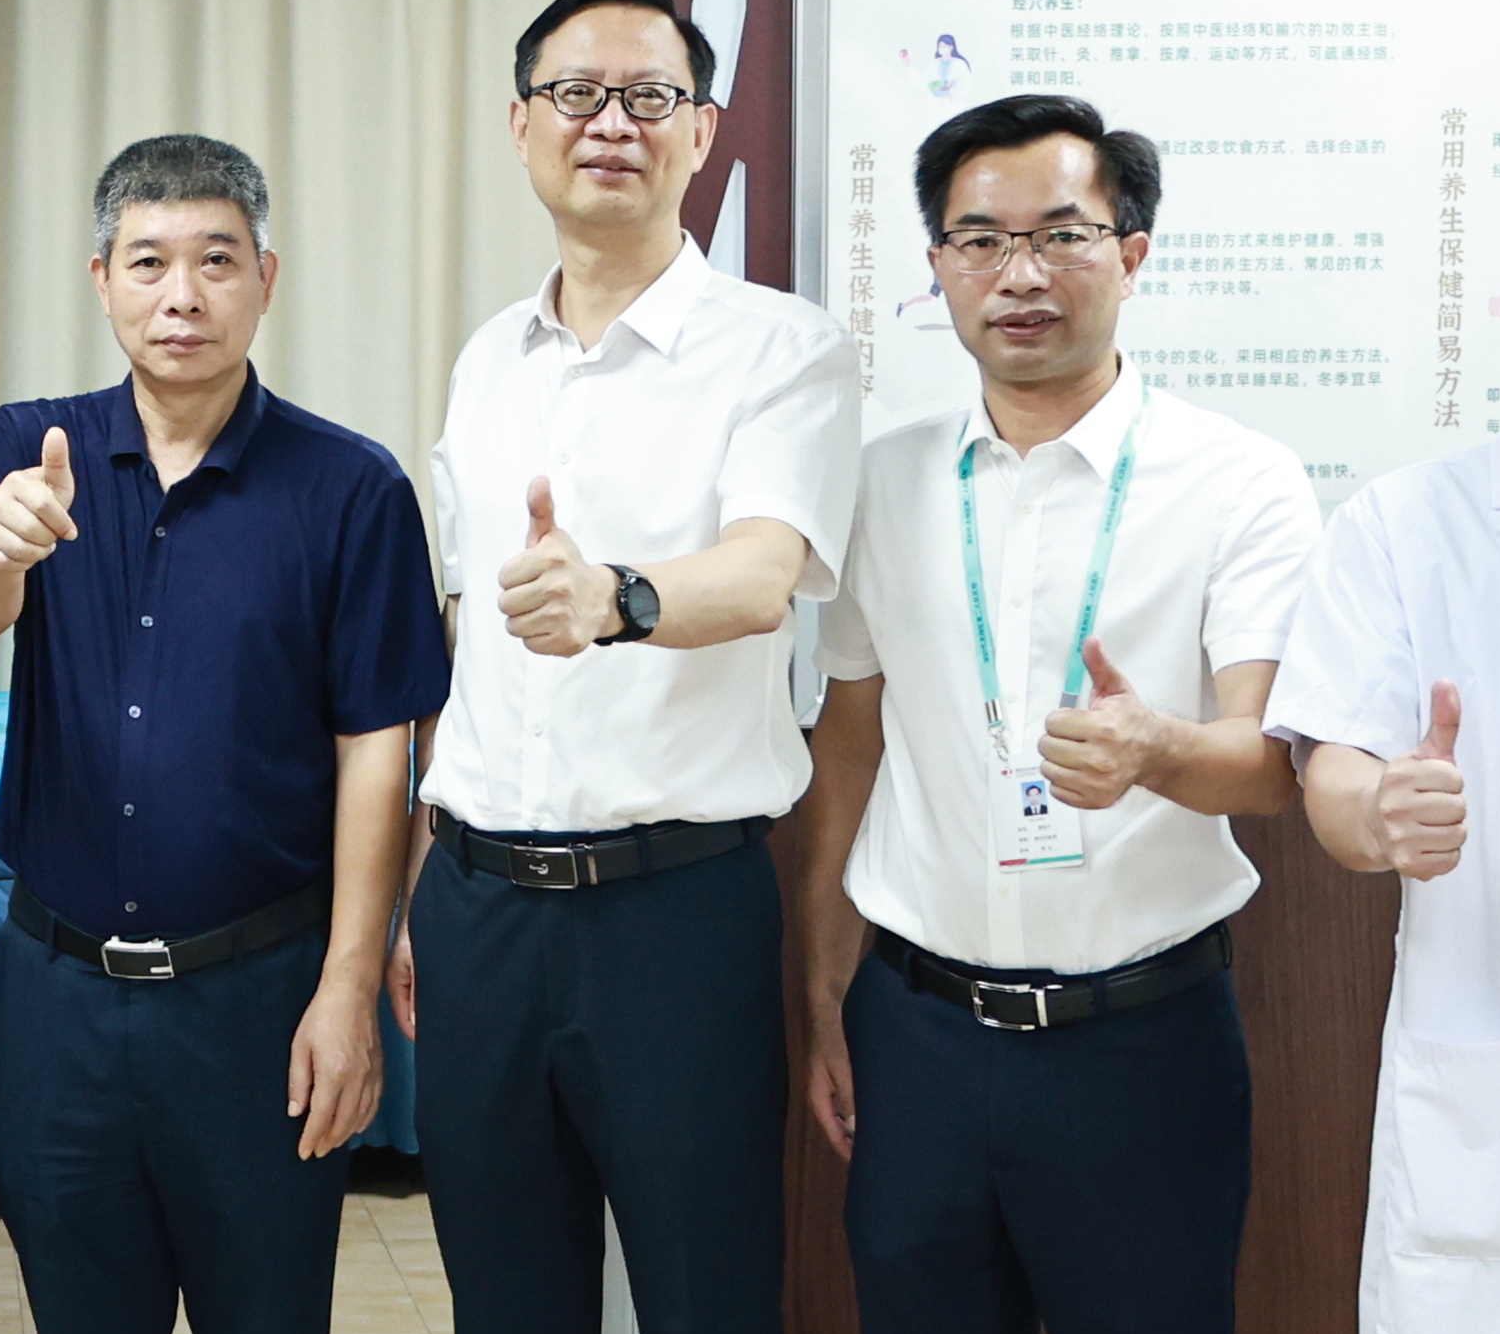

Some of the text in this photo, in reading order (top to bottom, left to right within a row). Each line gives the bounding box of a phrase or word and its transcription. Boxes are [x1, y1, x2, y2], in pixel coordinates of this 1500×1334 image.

[1130, 280, 1261, 296] 禽戏、六字诀等。
[1433, 106, 1468, 430] 常用养生保健简易方法
